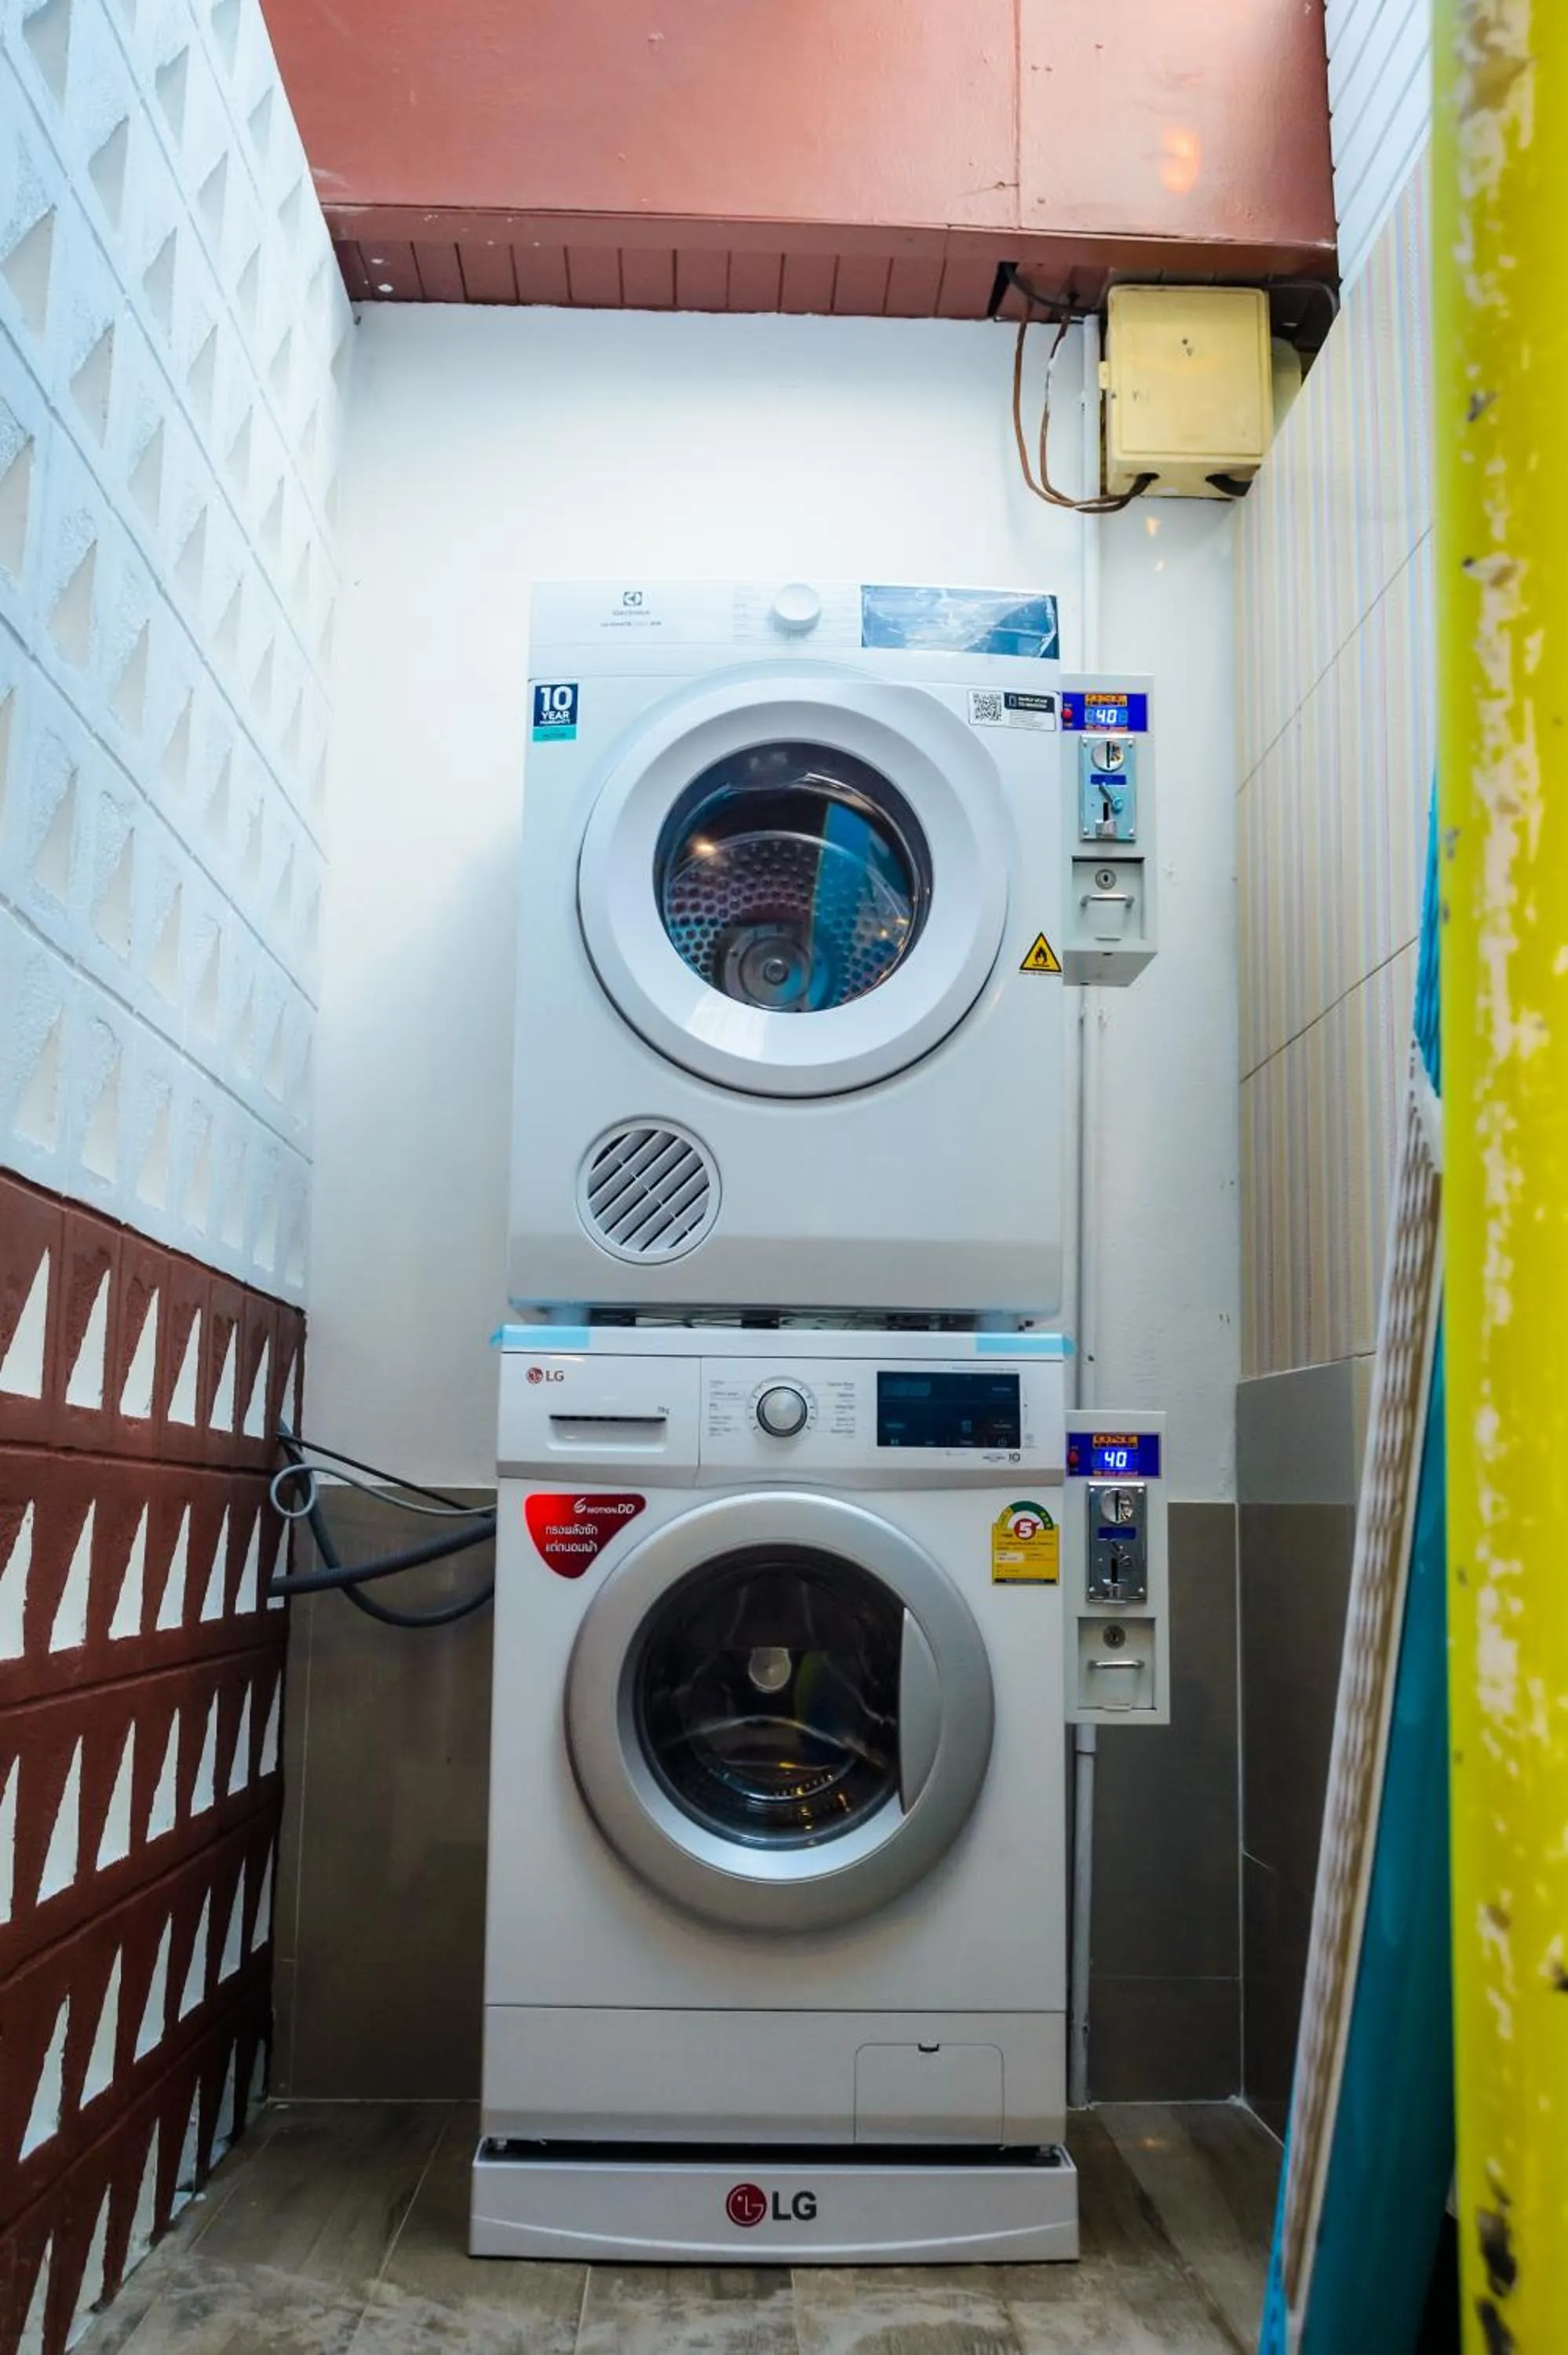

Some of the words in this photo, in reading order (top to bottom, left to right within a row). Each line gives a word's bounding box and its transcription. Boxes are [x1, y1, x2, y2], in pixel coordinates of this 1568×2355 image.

[541, 686, 573, 711] 10
[541, 710, 570, 721] YEAR
[1096, 709, 1118, 724] 40
[545, 1370, 564, 1382] LG
[1104, 1451, 1128, 1468] 40
[1018, 1521, 1034, 1538] 5
[771, 2190, 818, 2222] LG
